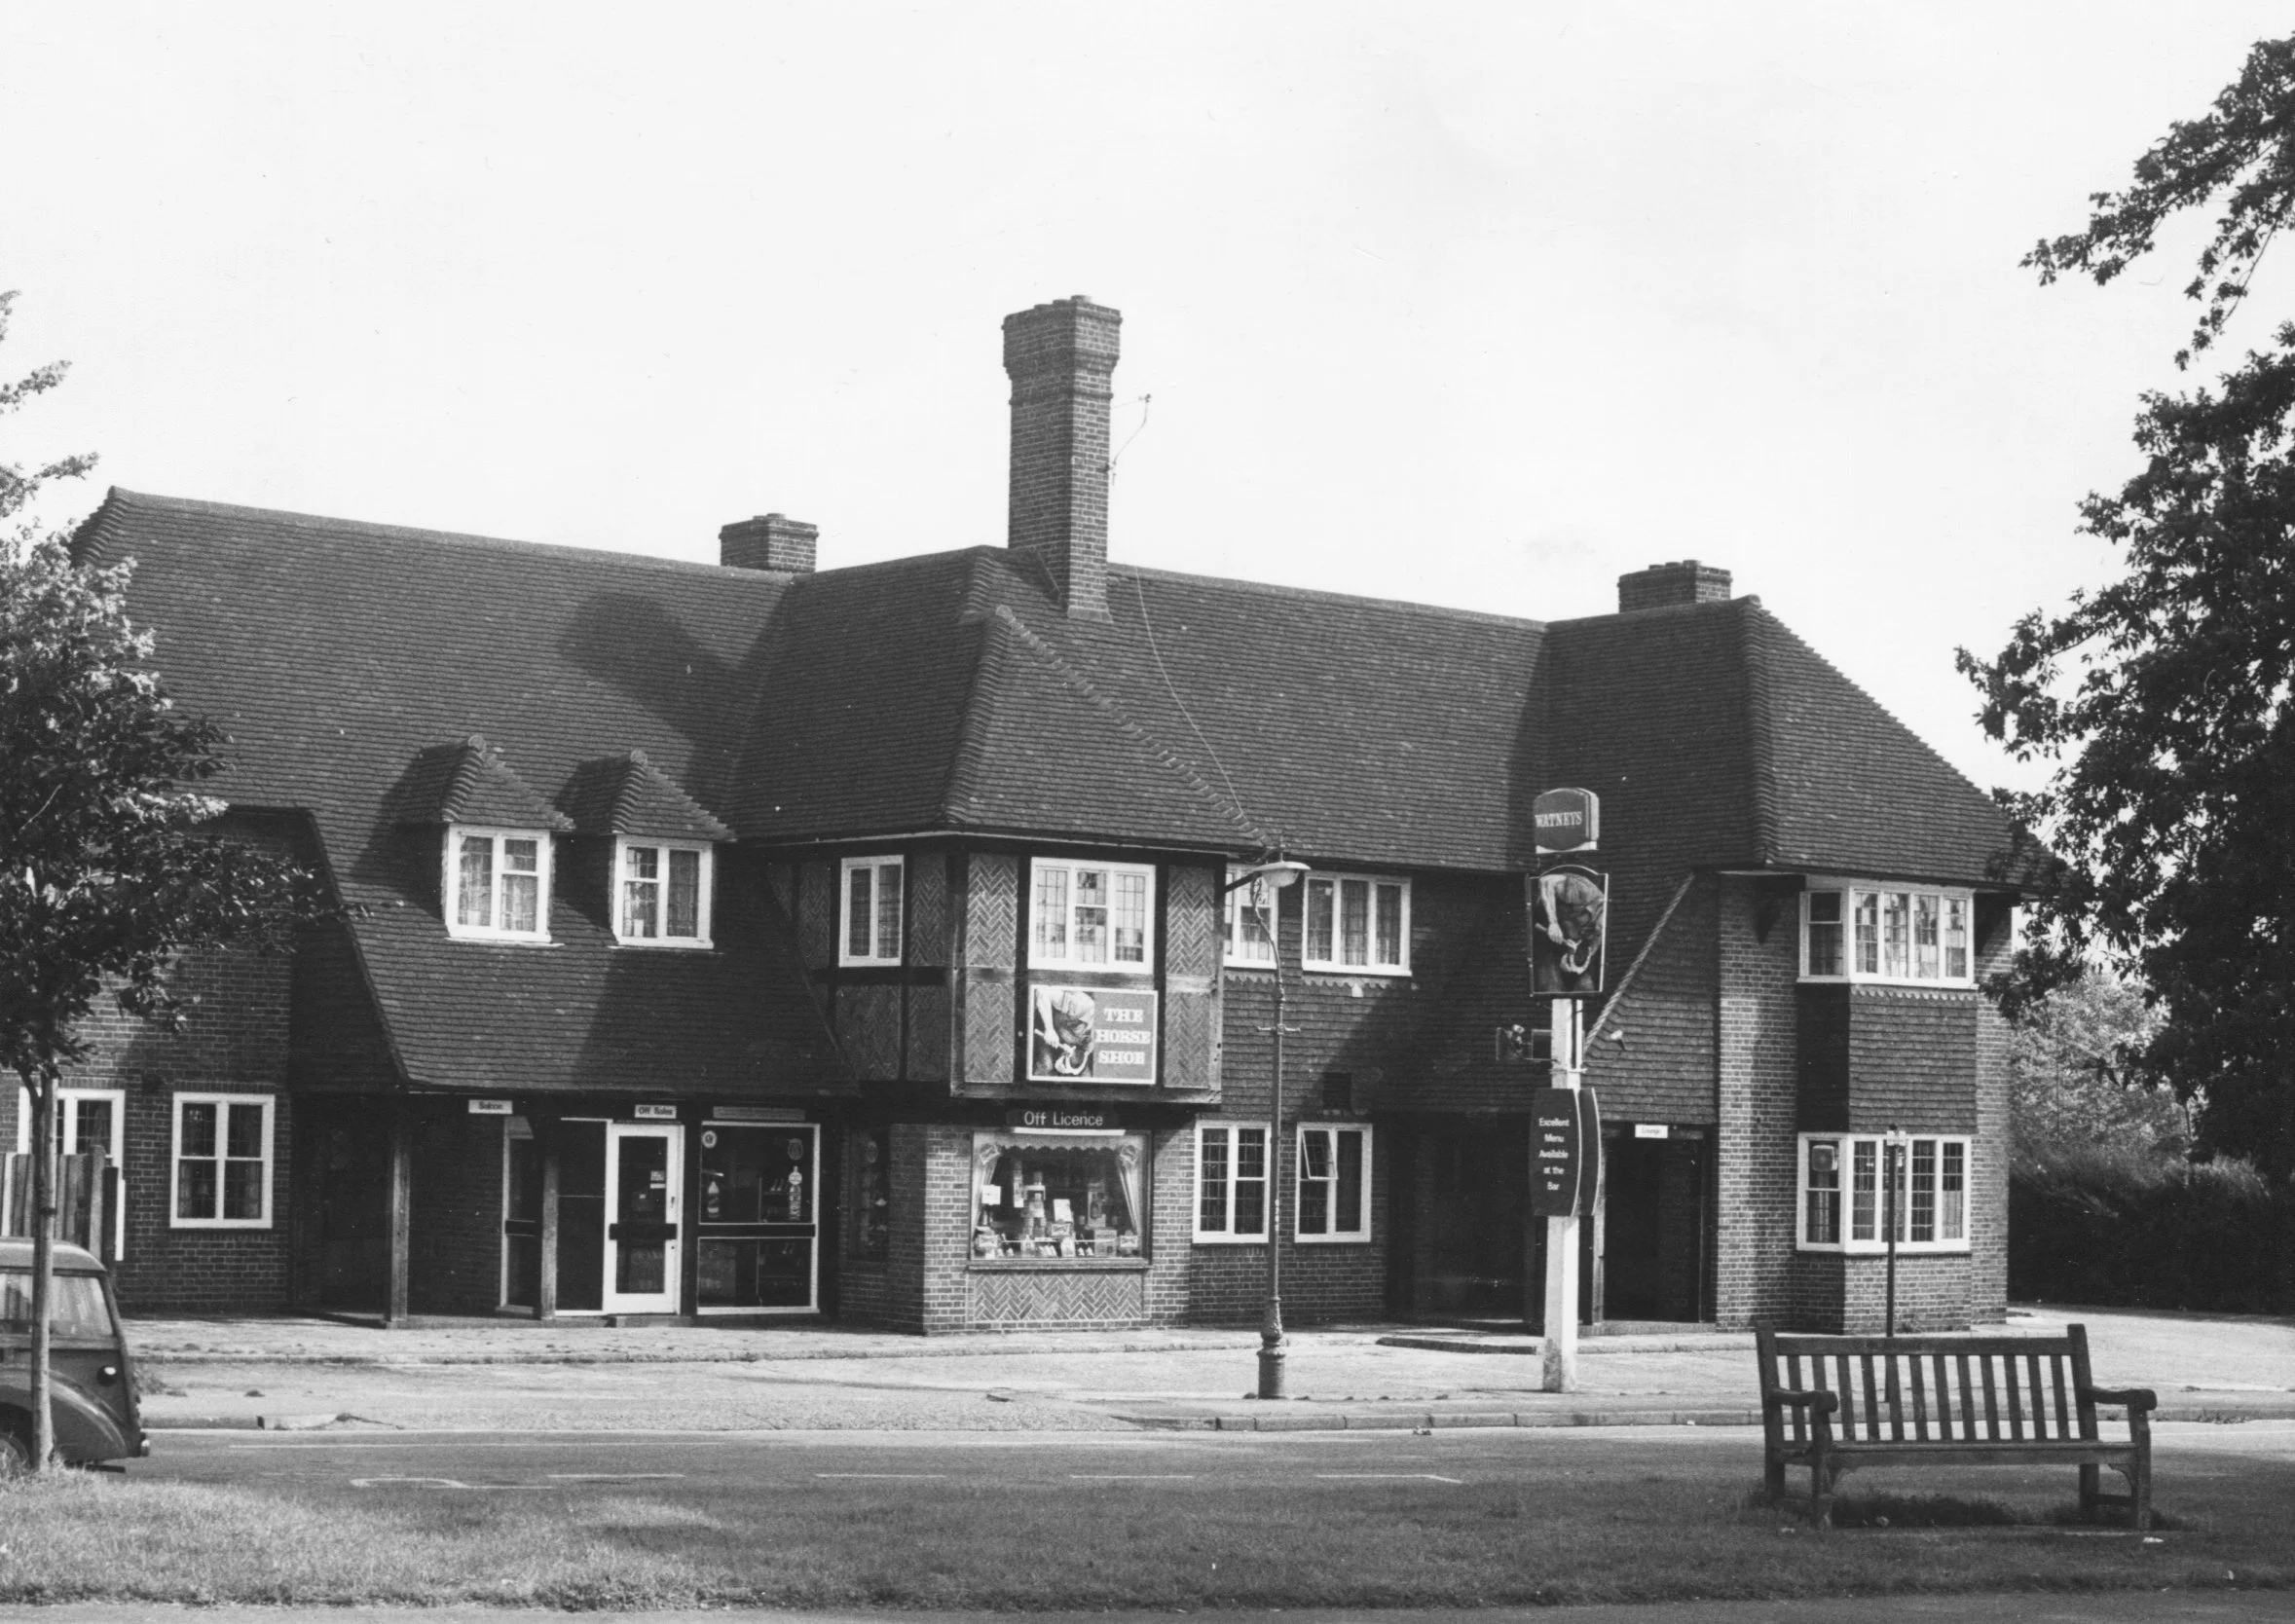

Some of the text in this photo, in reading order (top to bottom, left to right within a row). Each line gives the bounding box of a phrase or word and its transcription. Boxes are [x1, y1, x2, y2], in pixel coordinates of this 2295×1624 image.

[1535, 811, 1582, 828] WATNEYS
[1103, 1008, 1144, 1022] THE
[1094, 1029, 1151, 1044] HORSE
[1098, 1050, 1145, 1064] SHOE
[638, 1105, 651, 1116] Off
[1024, 1110, 1103, 1126] Off Licence
[1538, 1117, 1571, 1127] Excellent
[1544, 1133, 1565, 1143] Menu
[1538, 1150, 1570, 1159] Available
[1547, 1181, 1560, 1191] Bar
